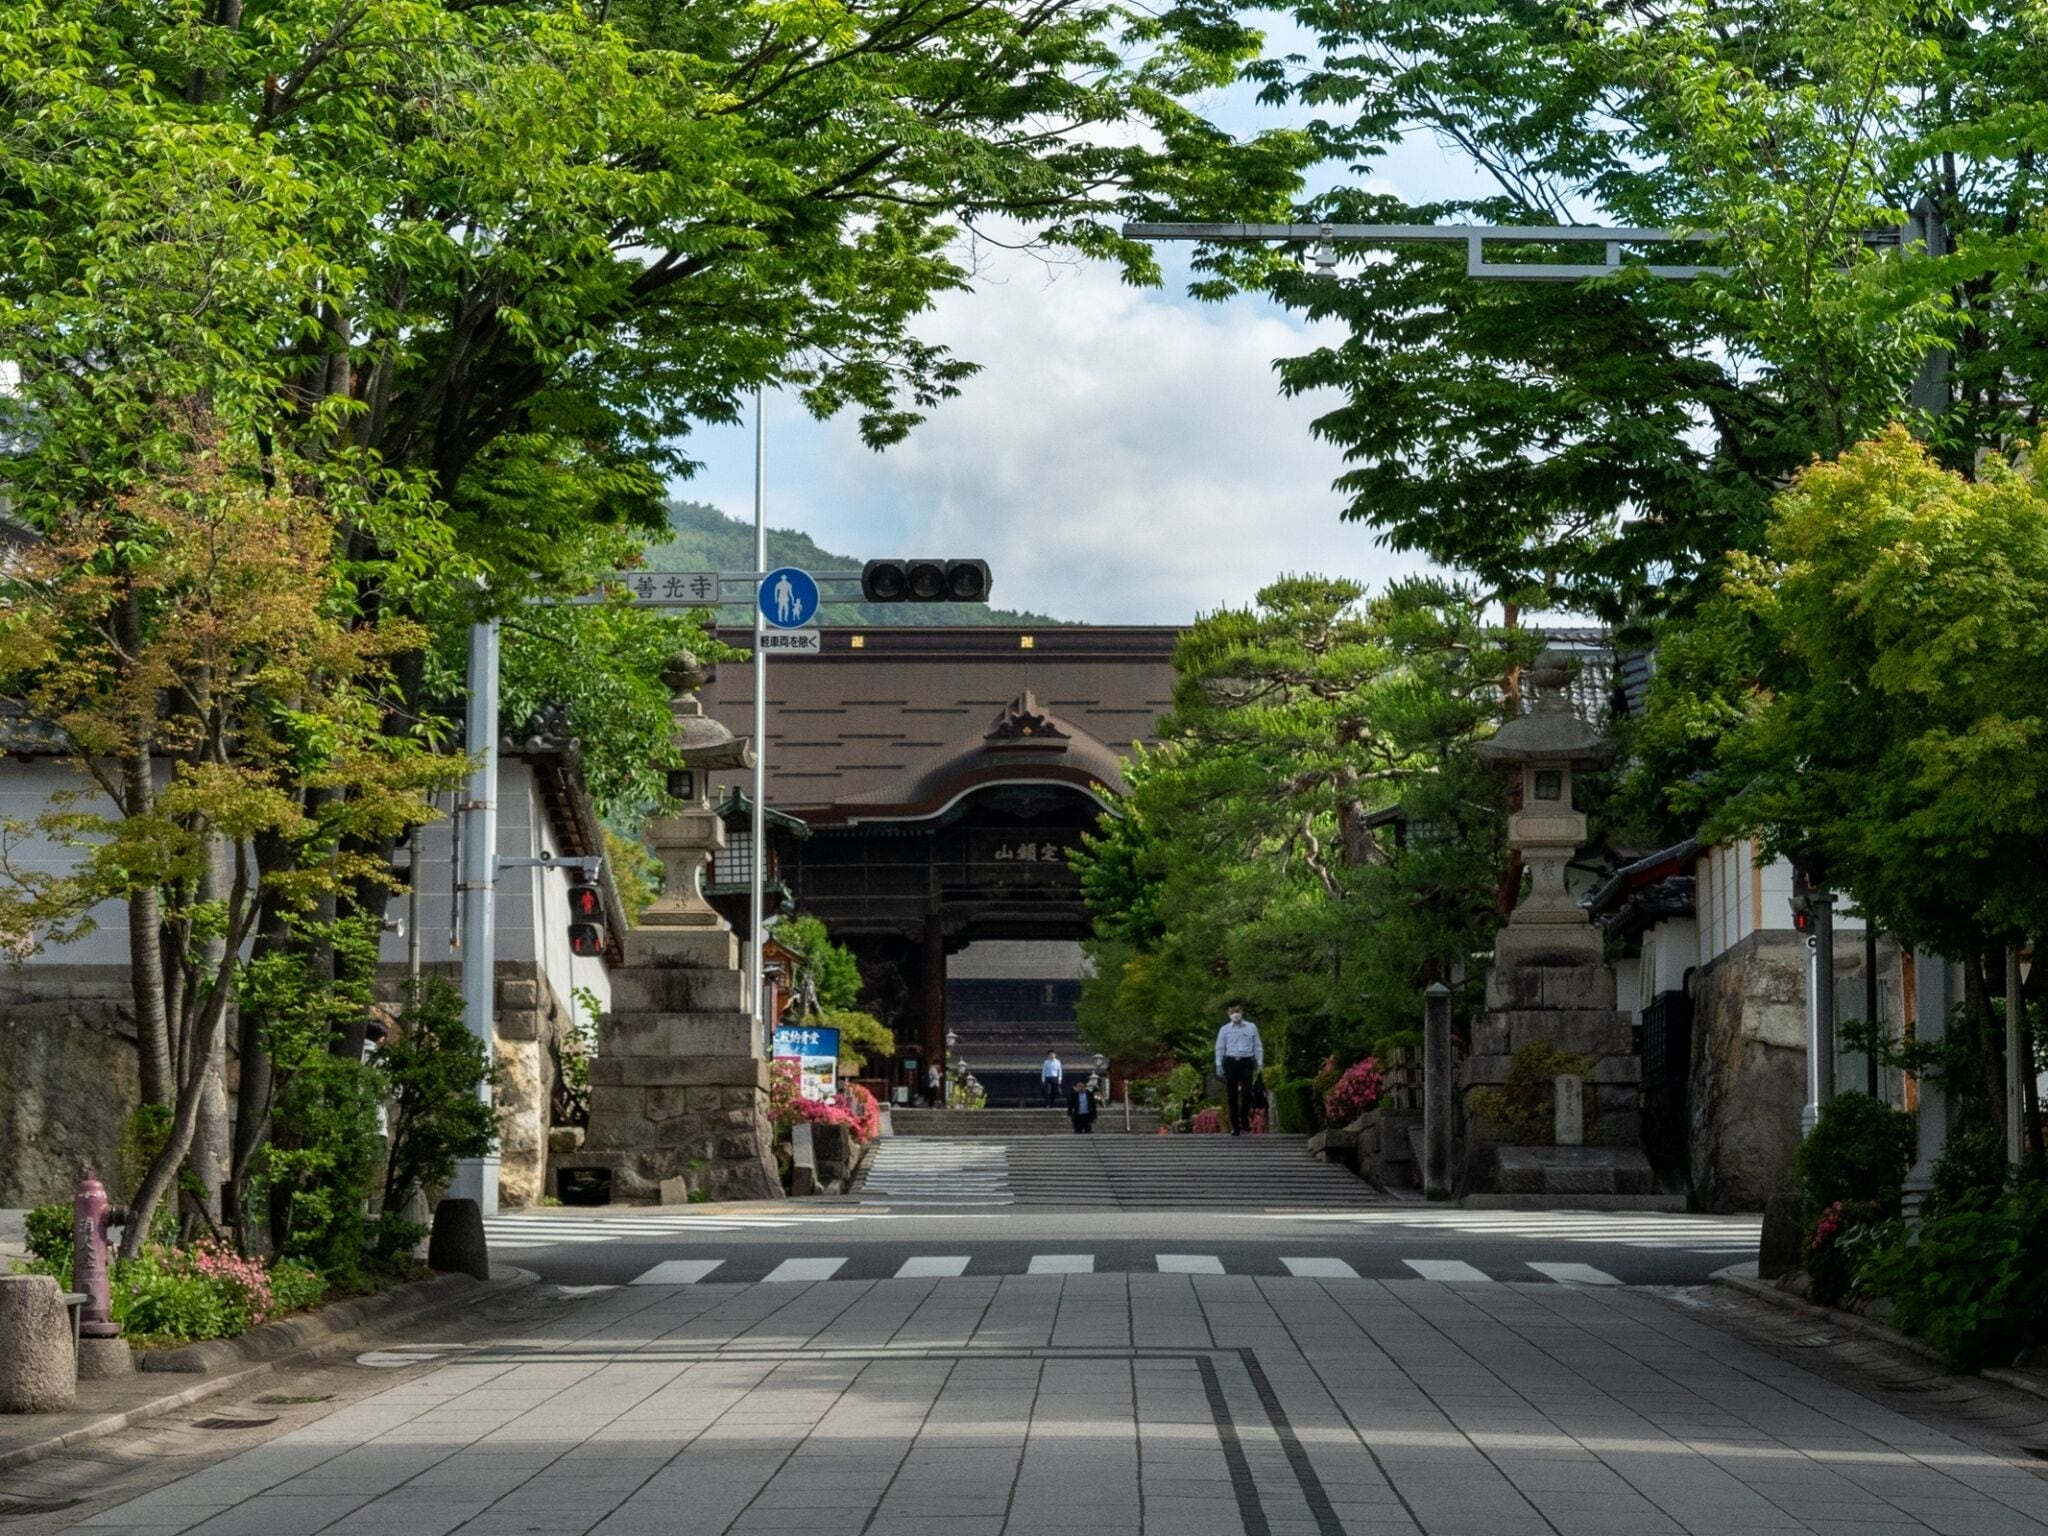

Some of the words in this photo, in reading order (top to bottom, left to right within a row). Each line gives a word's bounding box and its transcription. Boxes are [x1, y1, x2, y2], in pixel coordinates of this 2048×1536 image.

[634, 575, 713, 599] 善光寺
[760, 635, 817, 648] 軽車両を除く
